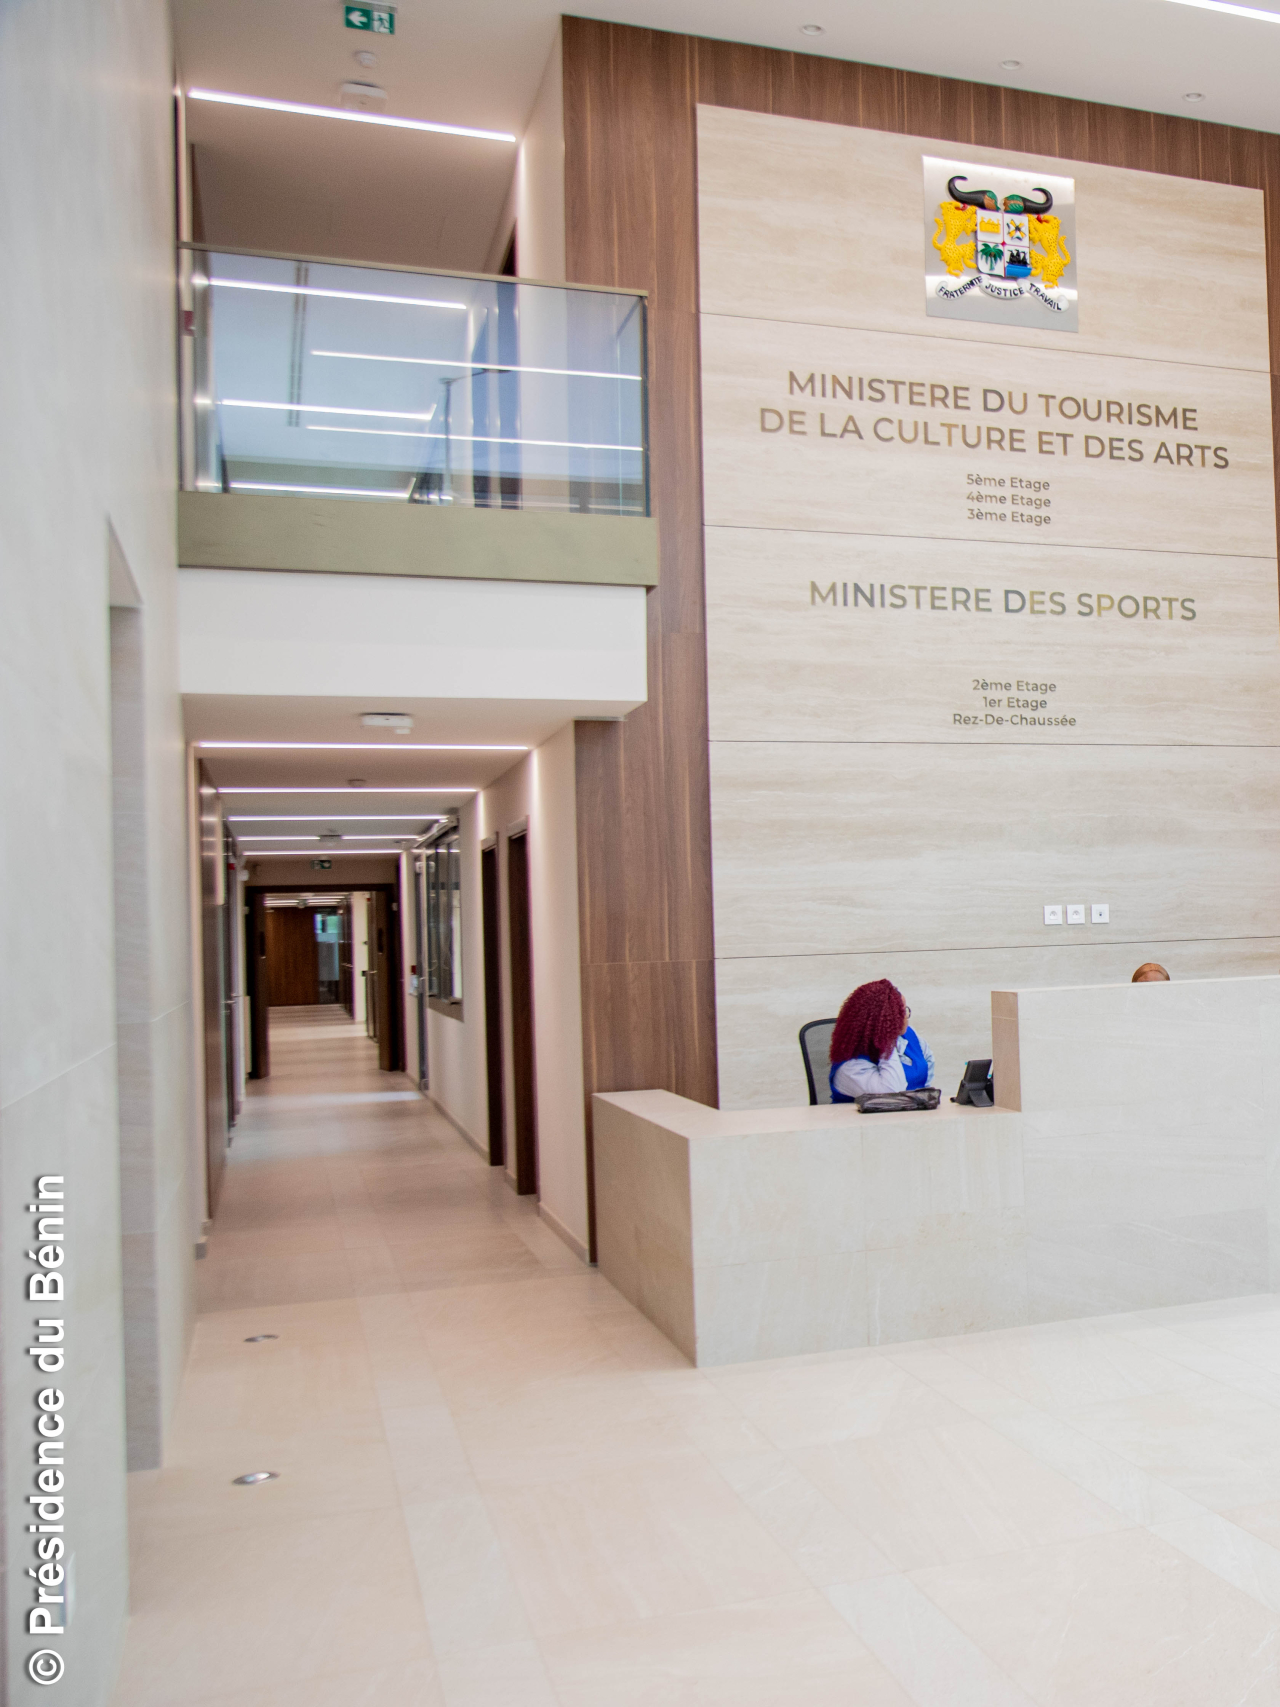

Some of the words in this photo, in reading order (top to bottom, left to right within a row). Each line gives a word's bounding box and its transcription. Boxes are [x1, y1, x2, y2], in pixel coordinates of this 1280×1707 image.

[985, 283, 1025, 297] JUSTICE
[1029, 283, 1062, 310] TRAVAIL
[788, 370, 971, 411] MINISTERE
[982, 388, 1028, 415] DU
[1038, 393, 1198, 431] TOURISME
[760, 407, 807, 436] DE
[820, 412, 864, 440] LA
[873, 416, 1027, 453] CULTURE
[1038, 430, 1074, 457] ET
[1084, 434, 1144, 463] DES
[1153, 441, 1229, 469] ARTS
[966, 473, 1006, 487] 5ème
[1010, 476, 1050, 492] Etage
[966, 490, 1007, 504] 4ème
[1011, 493, 1051, 509] Etage
[967, 508, 1007, 522] 3ème
[1011, 511, 1051, 526] Etage
[810, 580, 992, 613] MINISTERE
[1004, 589, 1066, 615] DES
[1077, 592, 1197, 621] SPORTS
[972, 679, 1012, 691] 2ème
[1016, 680, 1057, 694] Etage
[982, 696, 1003, 708] 1er
[1007, 697, 1048, 711] Etage
[953, 713, 1077, 726] Rez-De-Chaussée
